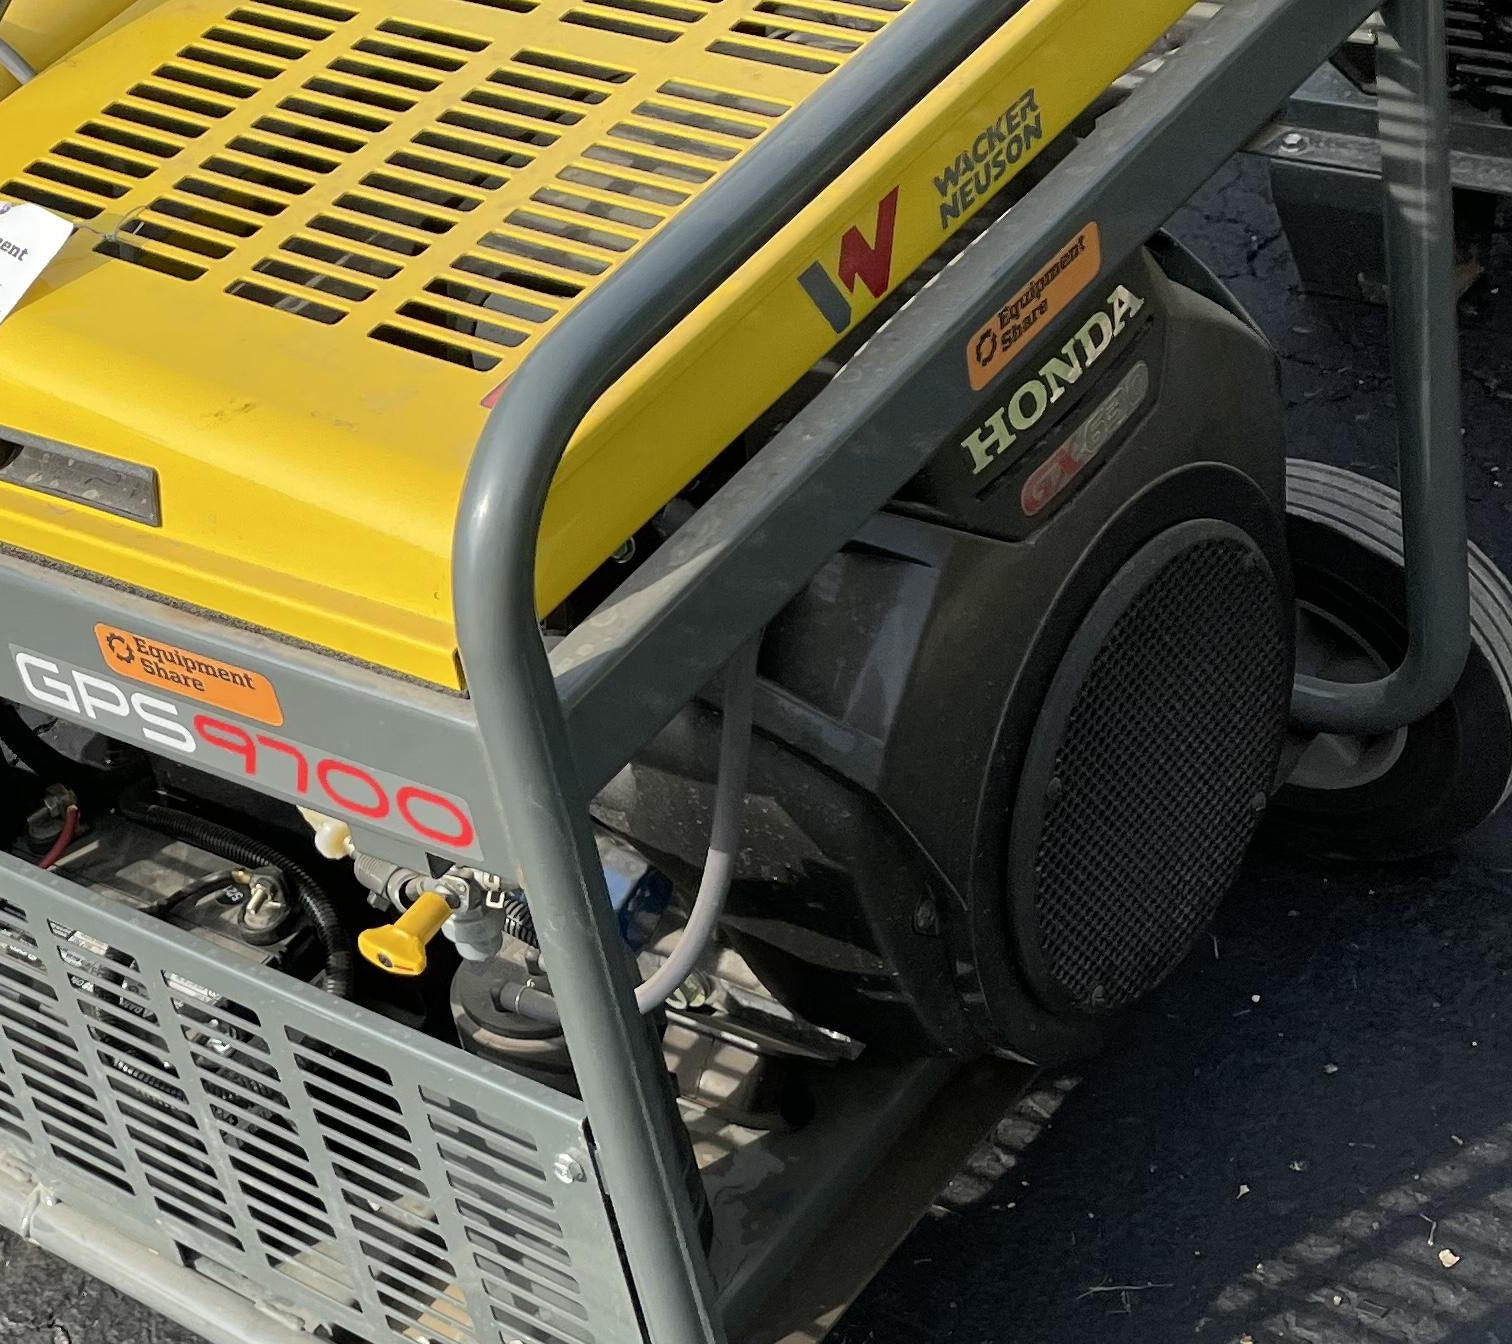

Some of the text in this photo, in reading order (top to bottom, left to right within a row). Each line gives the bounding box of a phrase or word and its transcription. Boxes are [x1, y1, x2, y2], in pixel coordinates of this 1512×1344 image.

[932, 87, 1038, 198] WACKER
[939, 111, 1044, 230] NEUSON
[997, 232, 1088, 330] Equipment
[1000, 295, 1050, 354] Share
[960, 284, 1146, 474] HONDA
[131, 635, 257, 693] Equipment
[139, 658, 206, 695] Share
